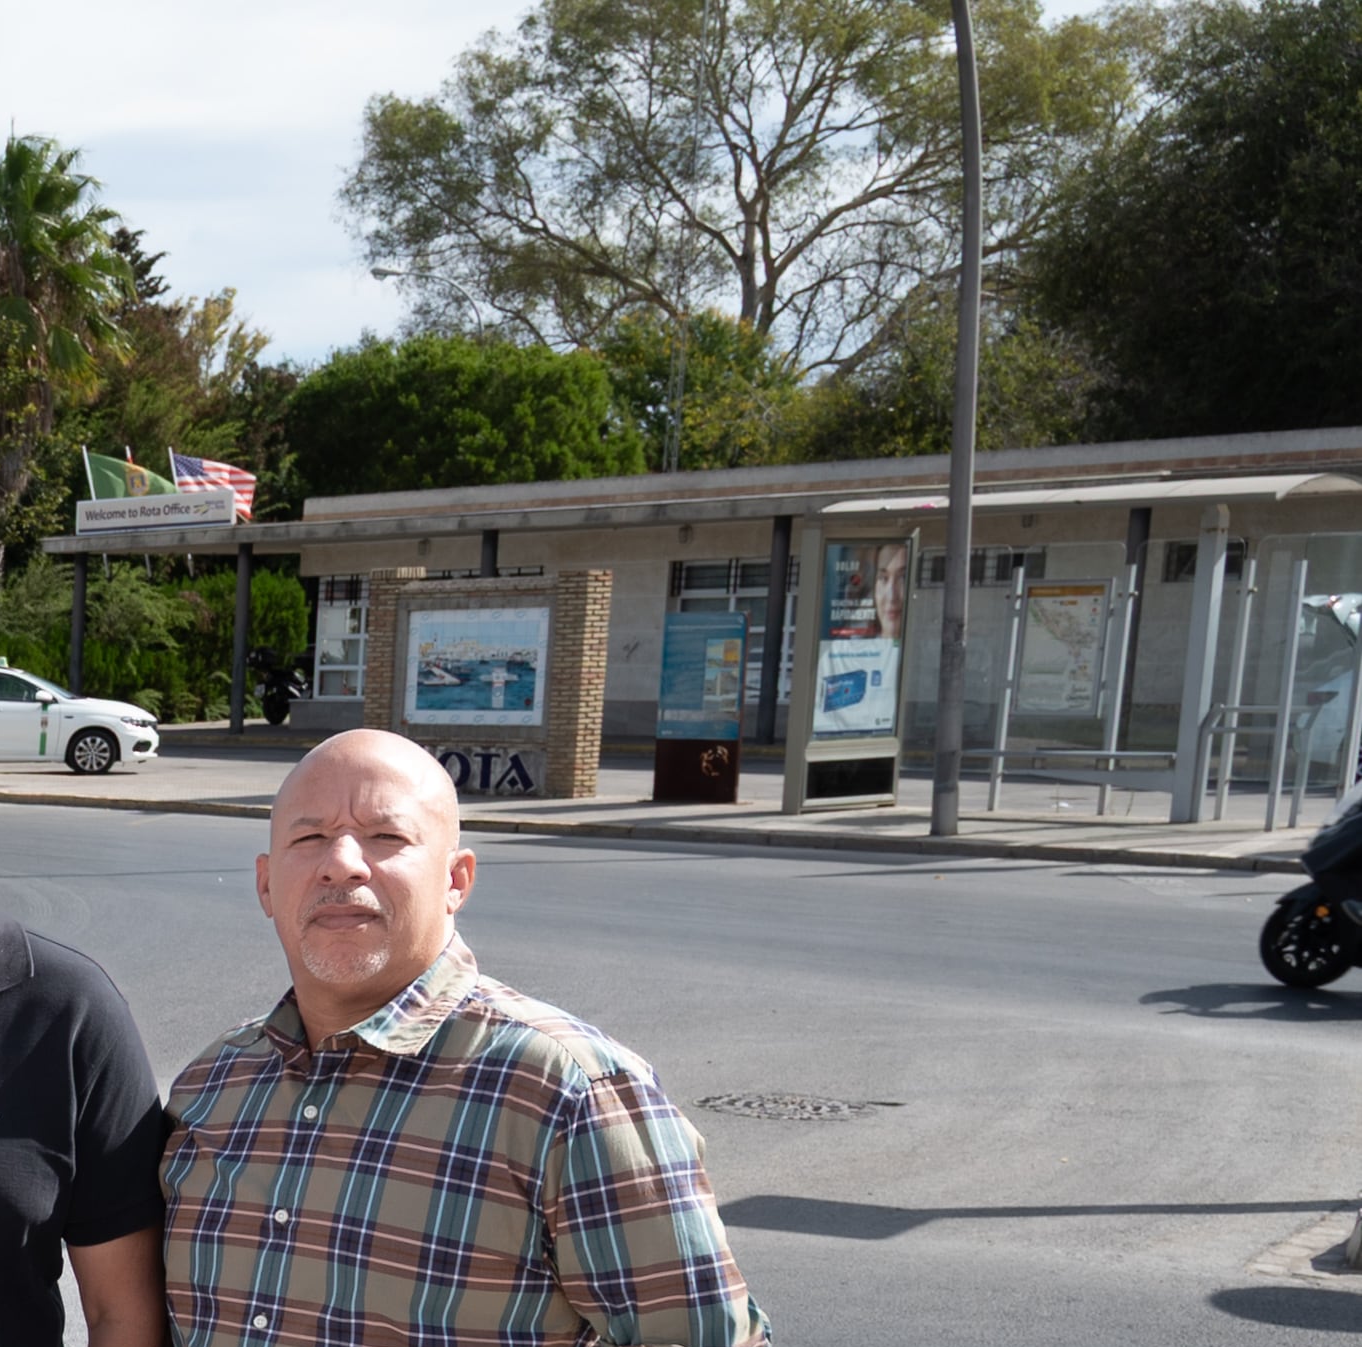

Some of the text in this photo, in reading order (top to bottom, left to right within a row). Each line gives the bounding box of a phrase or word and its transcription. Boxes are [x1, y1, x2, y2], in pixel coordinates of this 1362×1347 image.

[85, 508, 126, 521] Welcome
[128, 505, 138, 518] to
[140, 504, 161, 517] Rota
[163, 502, 191, 516] Office
[438, 751, 535, 792] OTA
